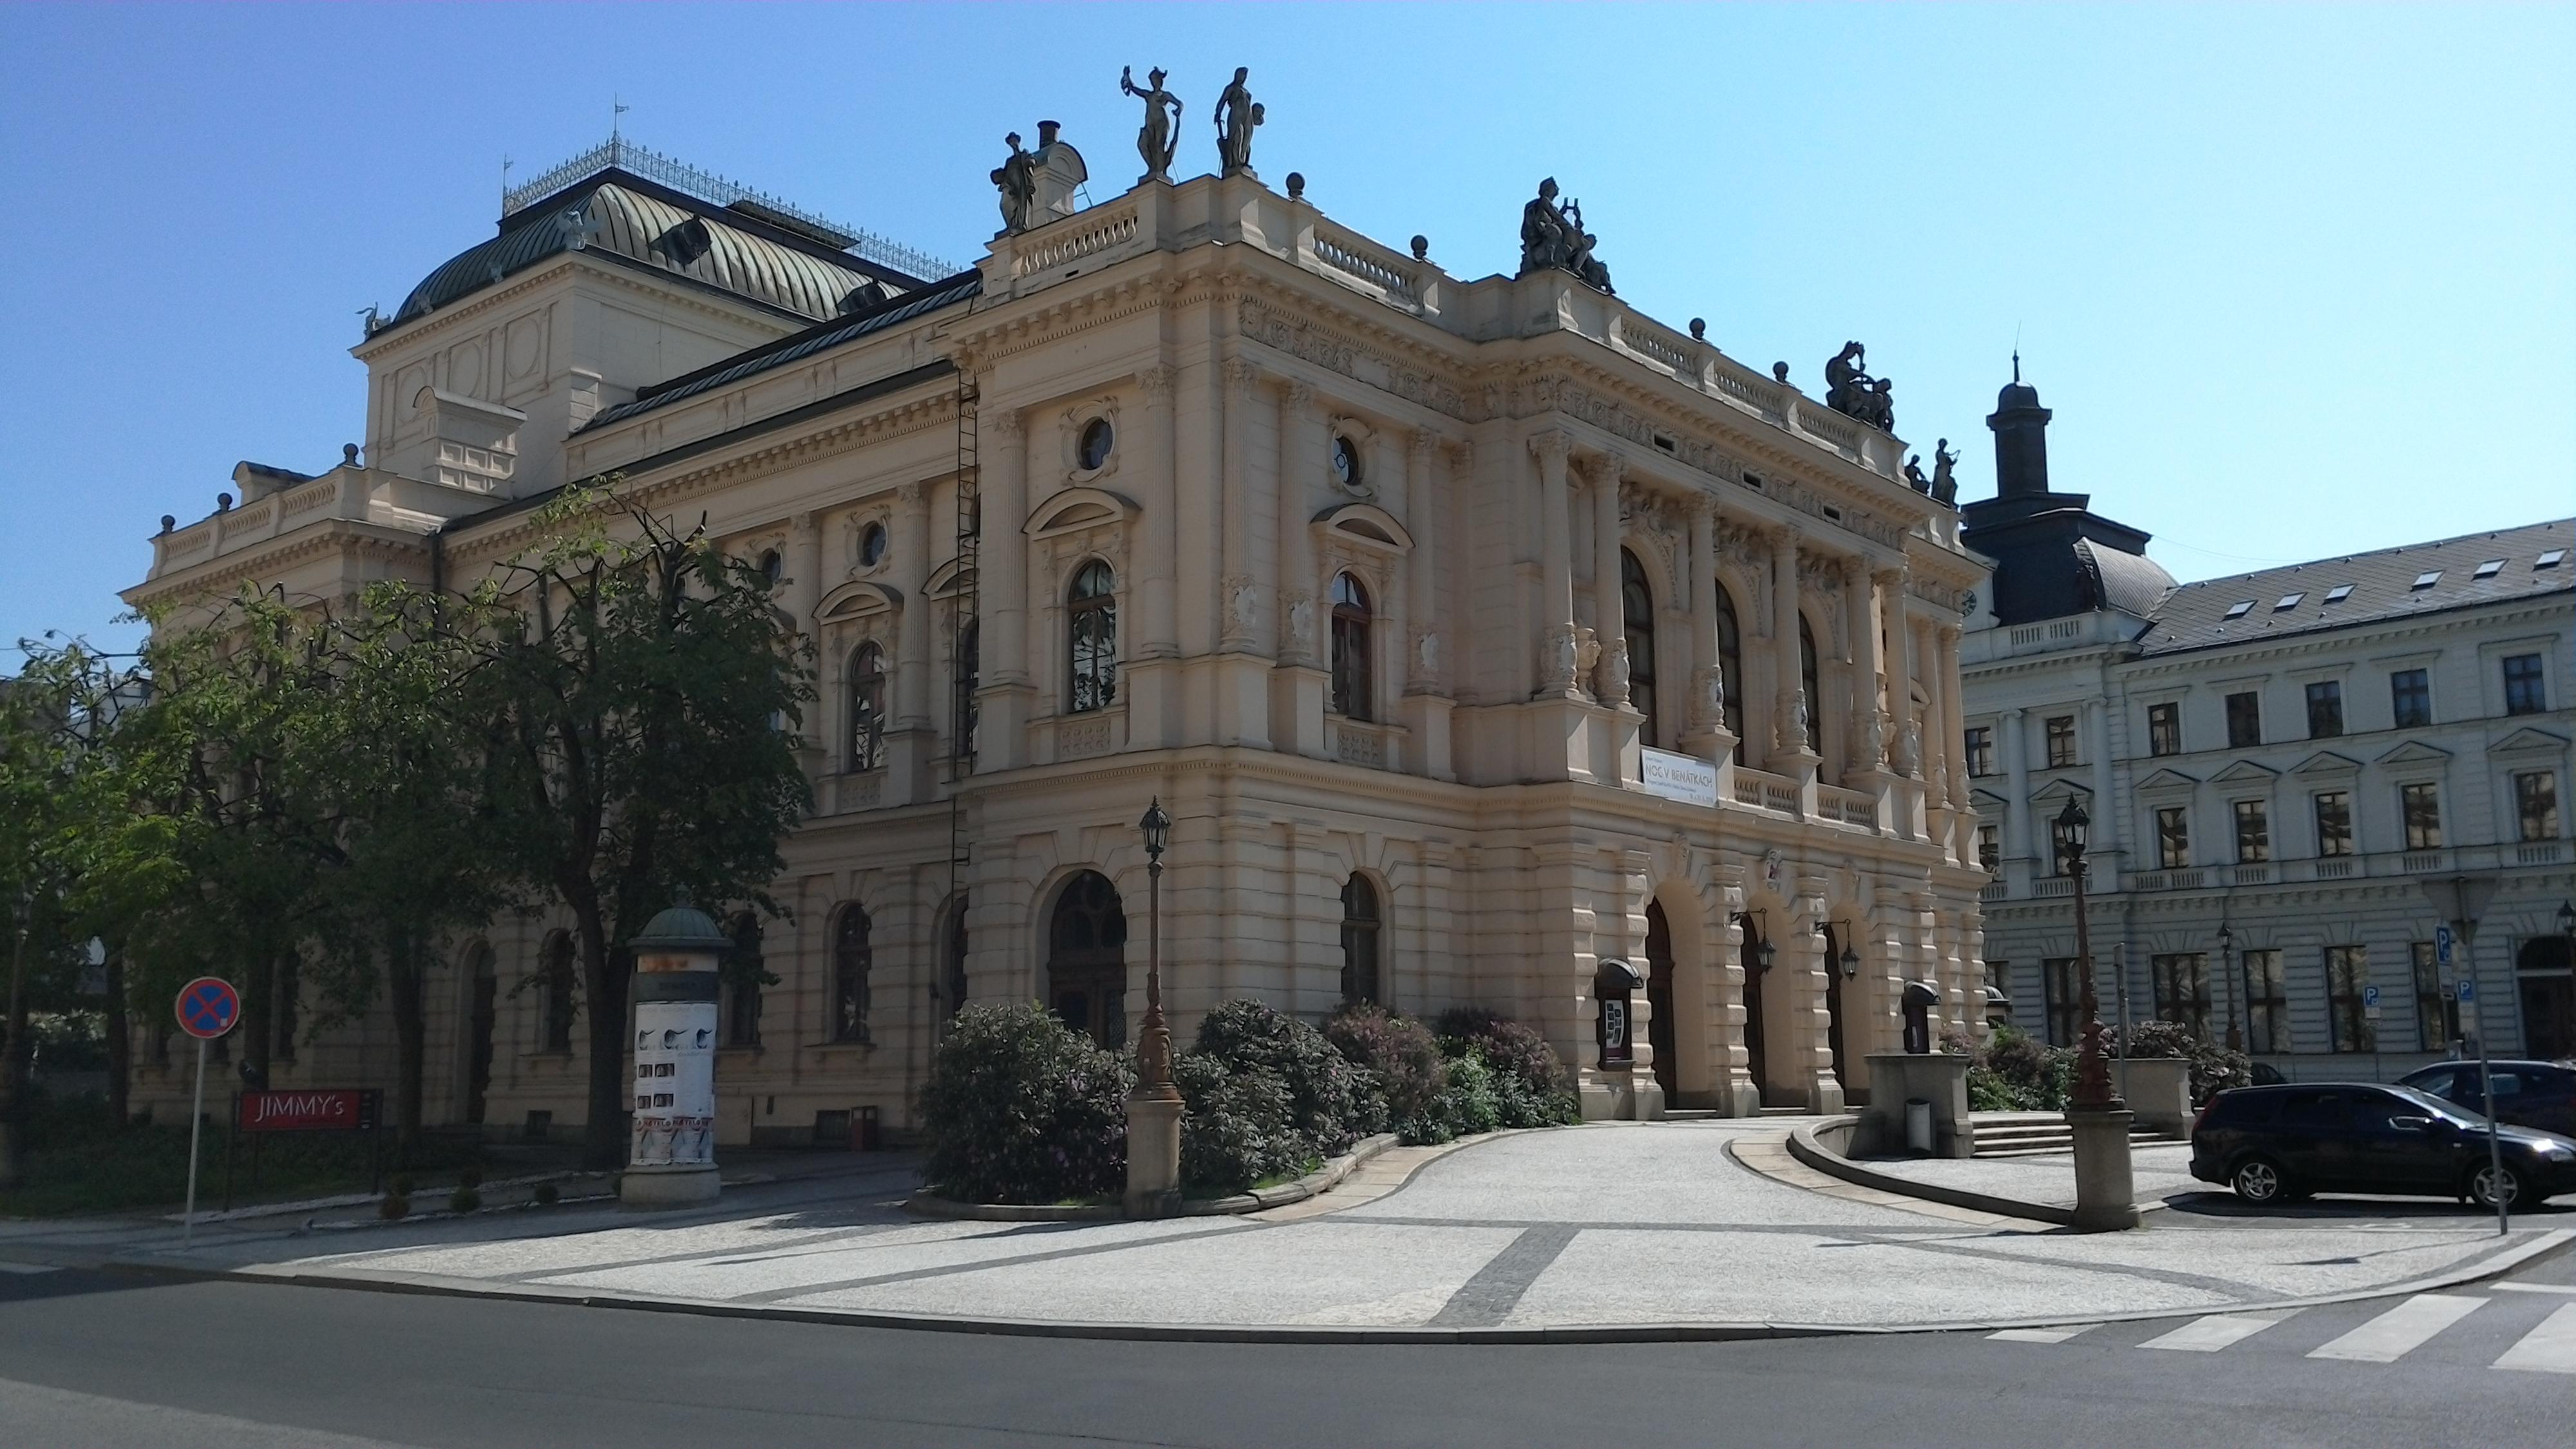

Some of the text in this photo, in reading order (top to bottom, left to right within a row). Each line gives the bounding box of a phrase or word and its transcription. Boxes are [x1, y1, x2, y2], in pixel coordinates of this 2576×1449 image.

[1645, 764, 1663, 777] NOC
[1663, 767, 1669, 779] V
[2439, 931, 2448, 951] P
[2367, 988, 2376, 1001] P
[2460, 981, 2470, 994] P
[254, 1094, 345, 1123] JIMMY's
